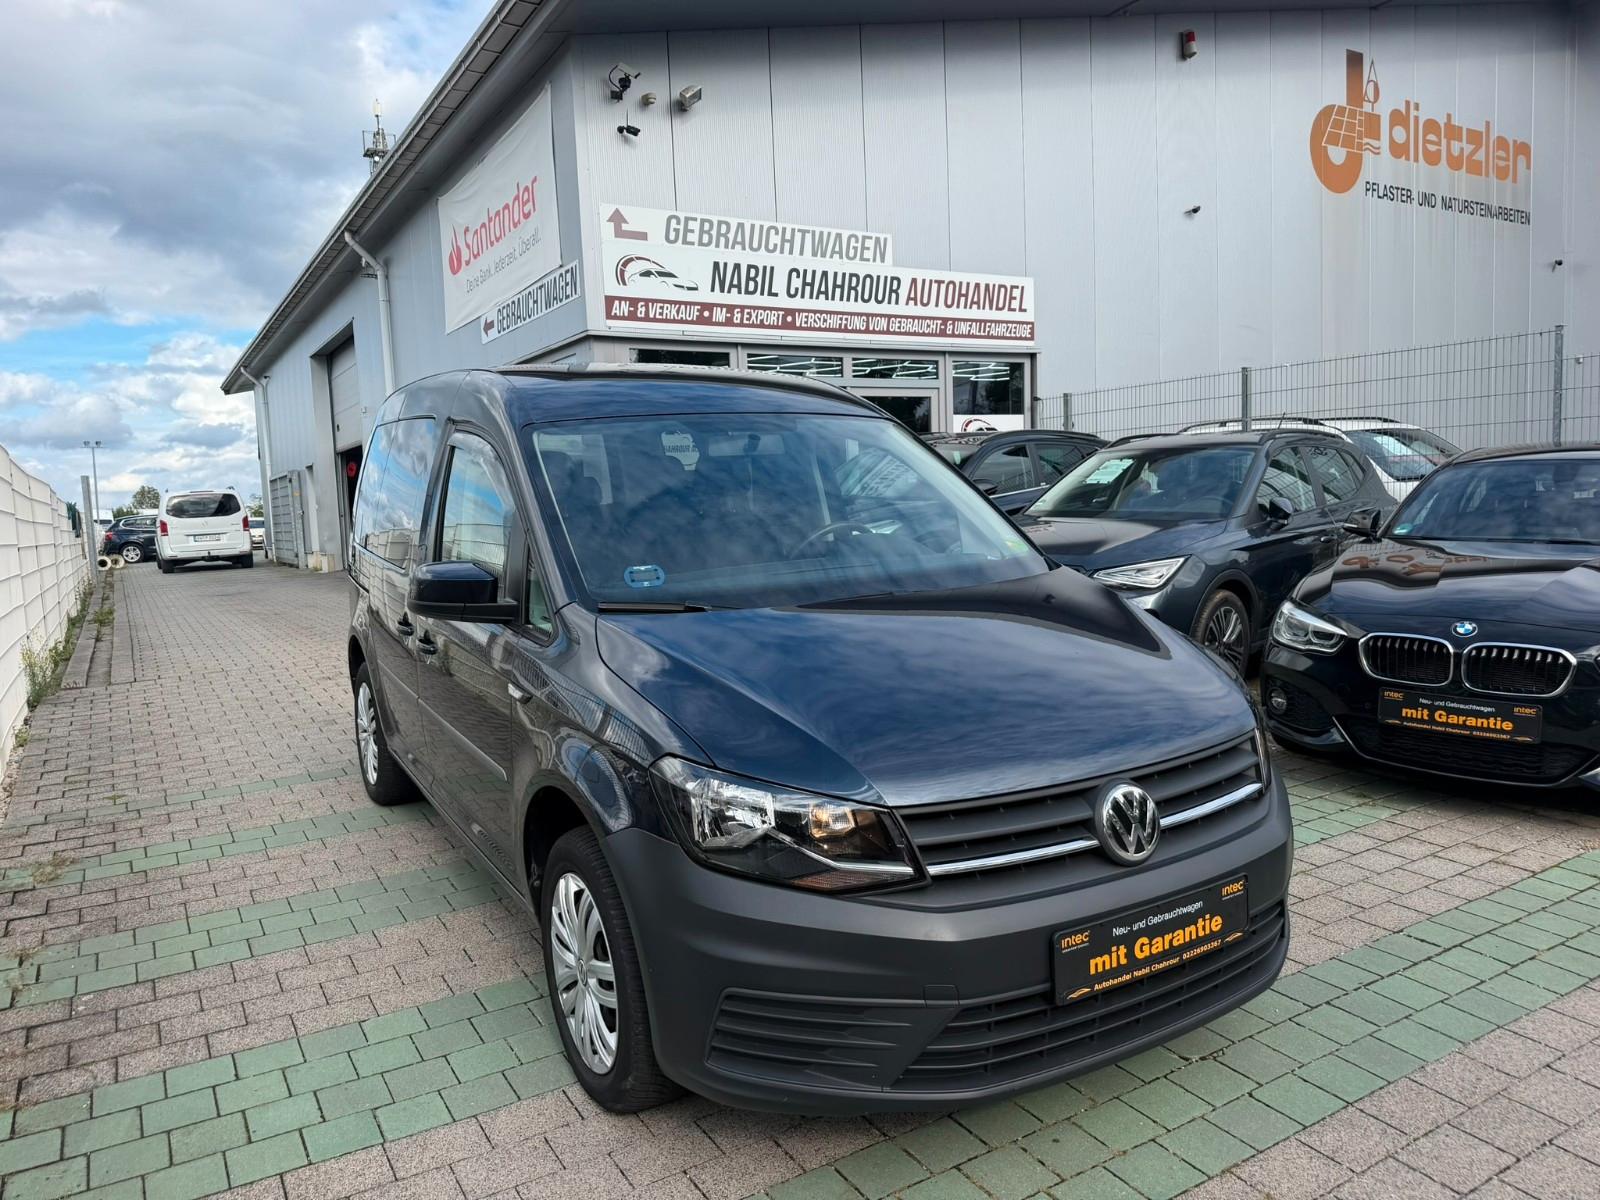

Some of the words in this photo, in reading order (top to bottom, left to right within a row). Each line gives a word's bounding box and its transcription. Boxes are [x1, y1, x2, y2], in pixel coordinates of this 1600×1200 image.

[1388, 99, 1532, 184] dietzler
[464, 175, 538, 267] Santander
[1365, 181, 1415, 204] PFLASTER-
[1418, 191, 1437, 209] UND
[1441, 195, 1531, 226] NATURSTEINARBEITEN
[664, 214, 888, 264] GEBRAUCHTWAGEN
[496, 265, 578, 334] GEBRAUCHTWAGEN
[710, 260, 779, 298] NABIL
[786, 267, 902, 305] CHAHROUR
[905, 277, 1028, 313] AUTOHANDEL
[611, 300, 634, 317] AN-
[637, 304, 645, 318] &
[648, 303, 701, 321] VERKAUF
[712, 307, 731, 323] IM-
[733, 308, 741, 323] &
[743, 309, 784, 326] EXPORT
[795, 312, 867, 330] VERSCHIFFUNG
[869, 316, 888, 331] VON
[889, 318, 945, 334] GEBRAUCHT-
[946, 320, 953, 335] &
[954, 321, 1033, 338] UNFALLFAHRZEUGE
[1384, 691, 1404, 699] intec
[1513, 707, 1537, 715] intec
[1402, 707, 1429, 720] mit
[1434, 710, 1514, 731] Garantie
[1446, 701, 1496, 713] Gebrauchtwagen
[1061, 930, 1091, 949] intec
[1221, 880, 1245, 897] intec
[1112, 925, 1131, 937] Neu-
[1132, 920, 1146, 931] und
[1147, 900, 1203, 926] Gebrauchtwagen
[1089, 944, 1128, 975] mit
[1134, 913, 1223, 960] Garantie
[1094, 974, 1132, 991] Autohandel
[1133, 966, 1150, 978] Nabil
[1151, 957, 1180, 972] Chahrour
